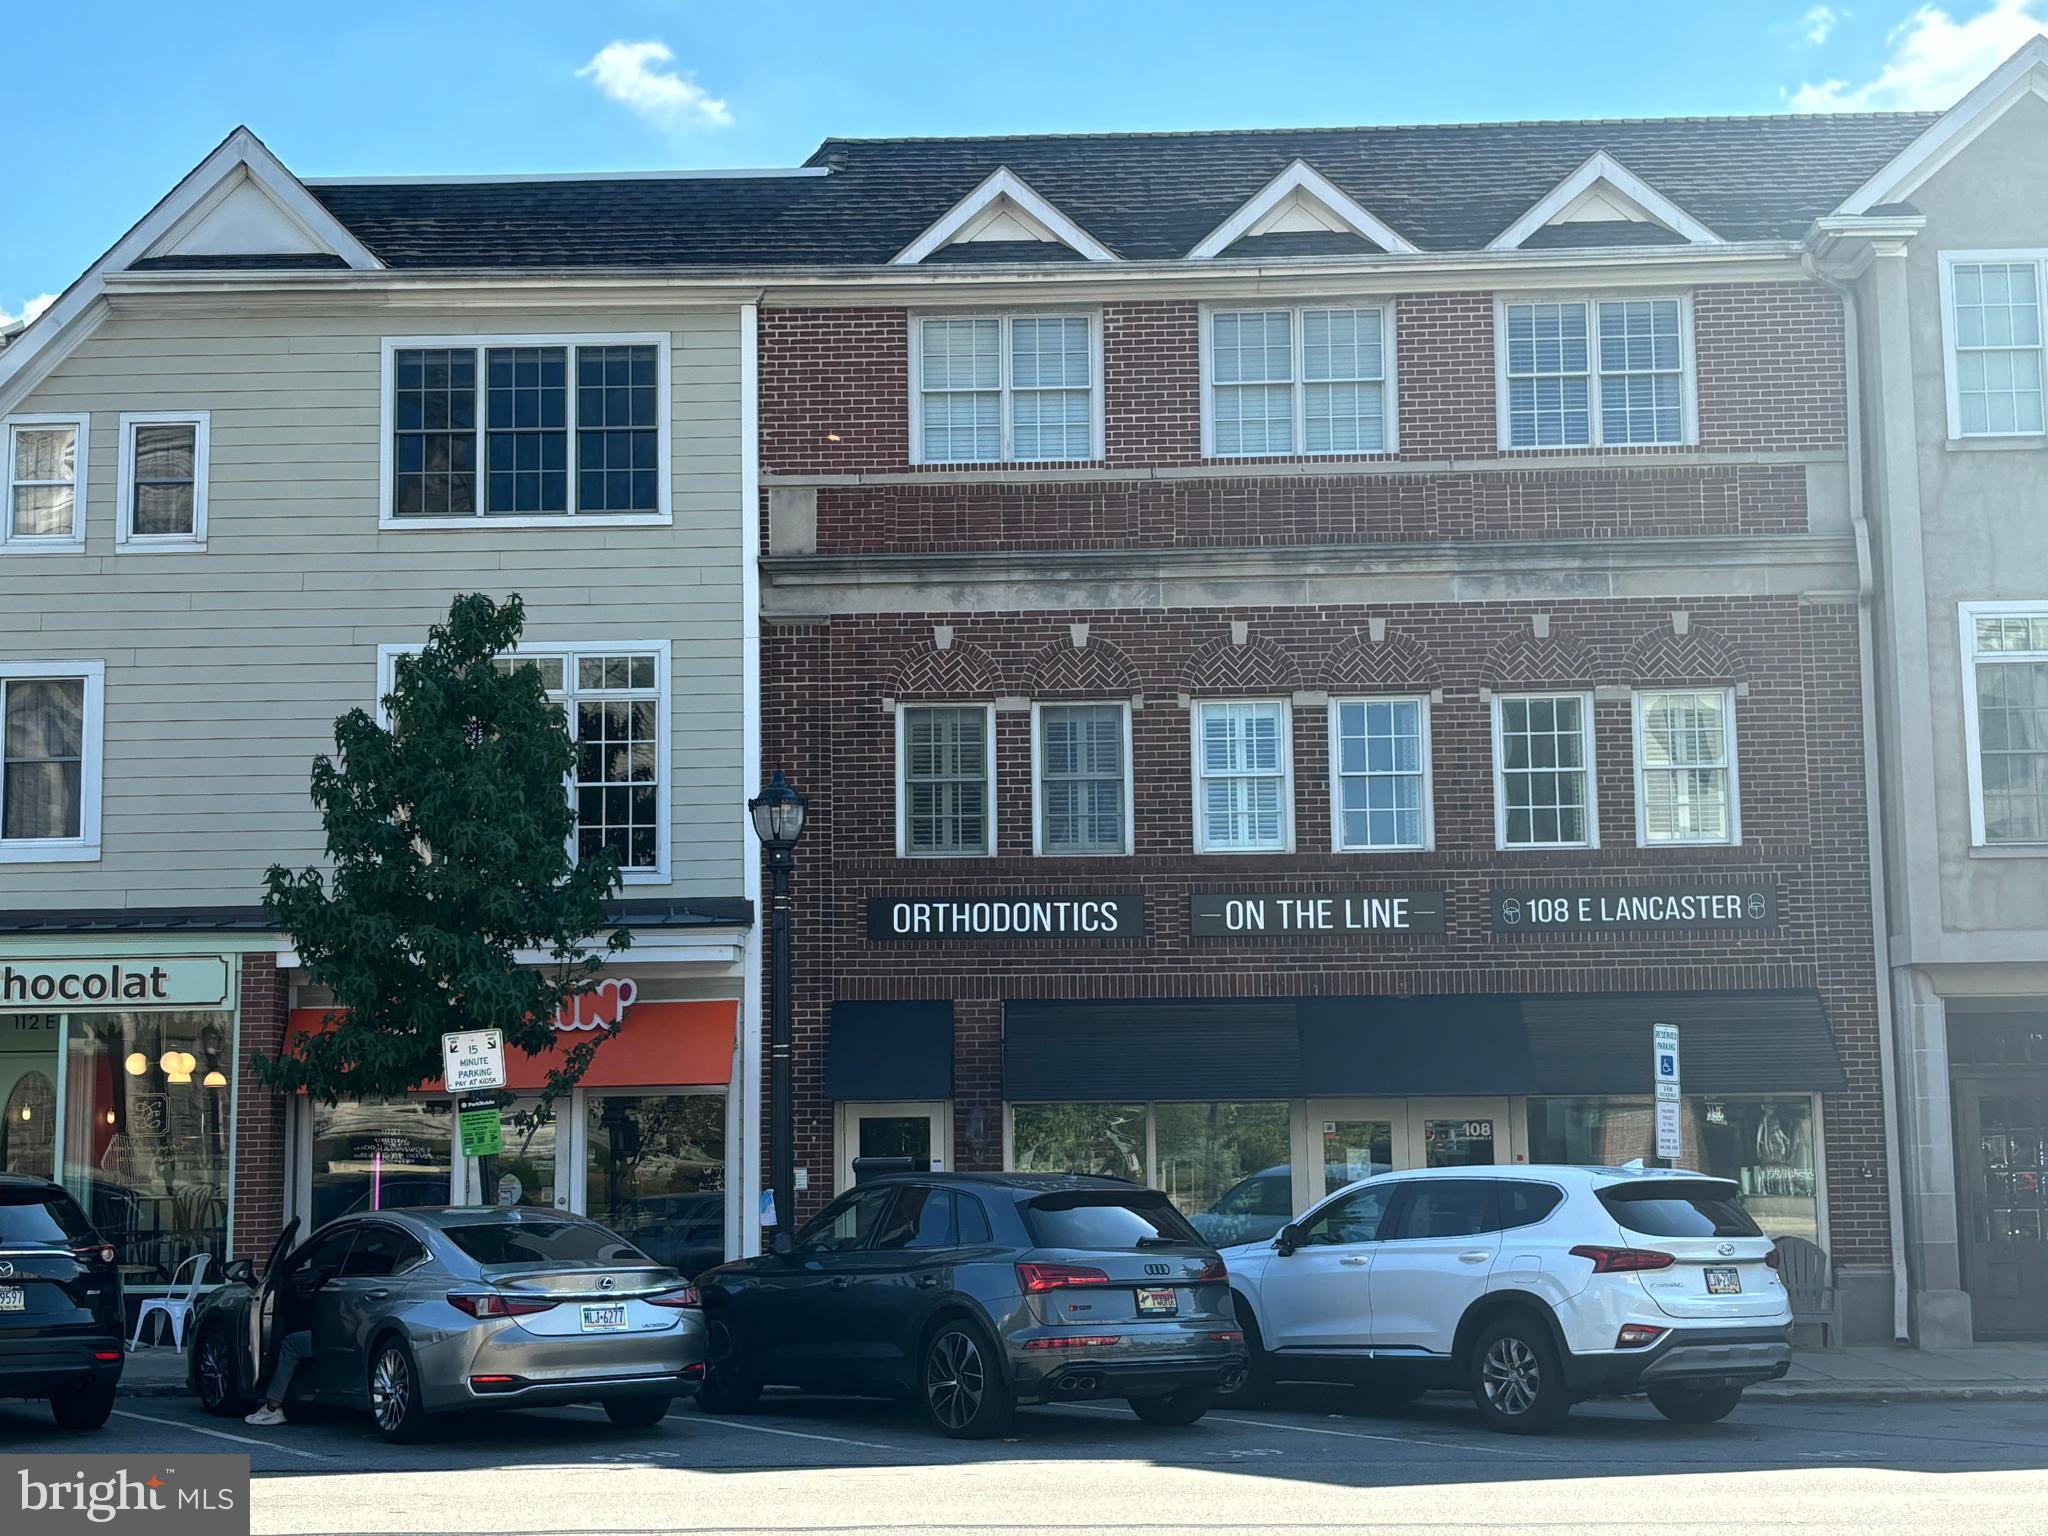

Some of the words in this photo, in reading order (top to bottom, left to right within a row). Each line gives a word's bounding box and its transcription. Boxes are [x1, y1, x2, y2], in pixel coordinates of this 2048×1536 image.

[1226, 900, 1265, 930] ON
[1276, 899, 1334, 930] THE
[1345, 898, 1410, 929] LINE
[1526, 897, 1569, 923] 108
[1578, 897, 1592, 922] E
[1600, 895, 1742, 922] LANCASTER
[893, 902, 1118, 933] ORTHODONTICS
[0, 965, 168, 1000] hocolat
[13, 1015, 39, 1030] 112
[46, 1014, 56, 1030] E
[468, 1045, 479, 1055] 15
[460, 1057, 489, 1067] MINUTE
[458, 1068, 492, 1078] PARKING
[1463, 1122, 1491, 1136] 108
